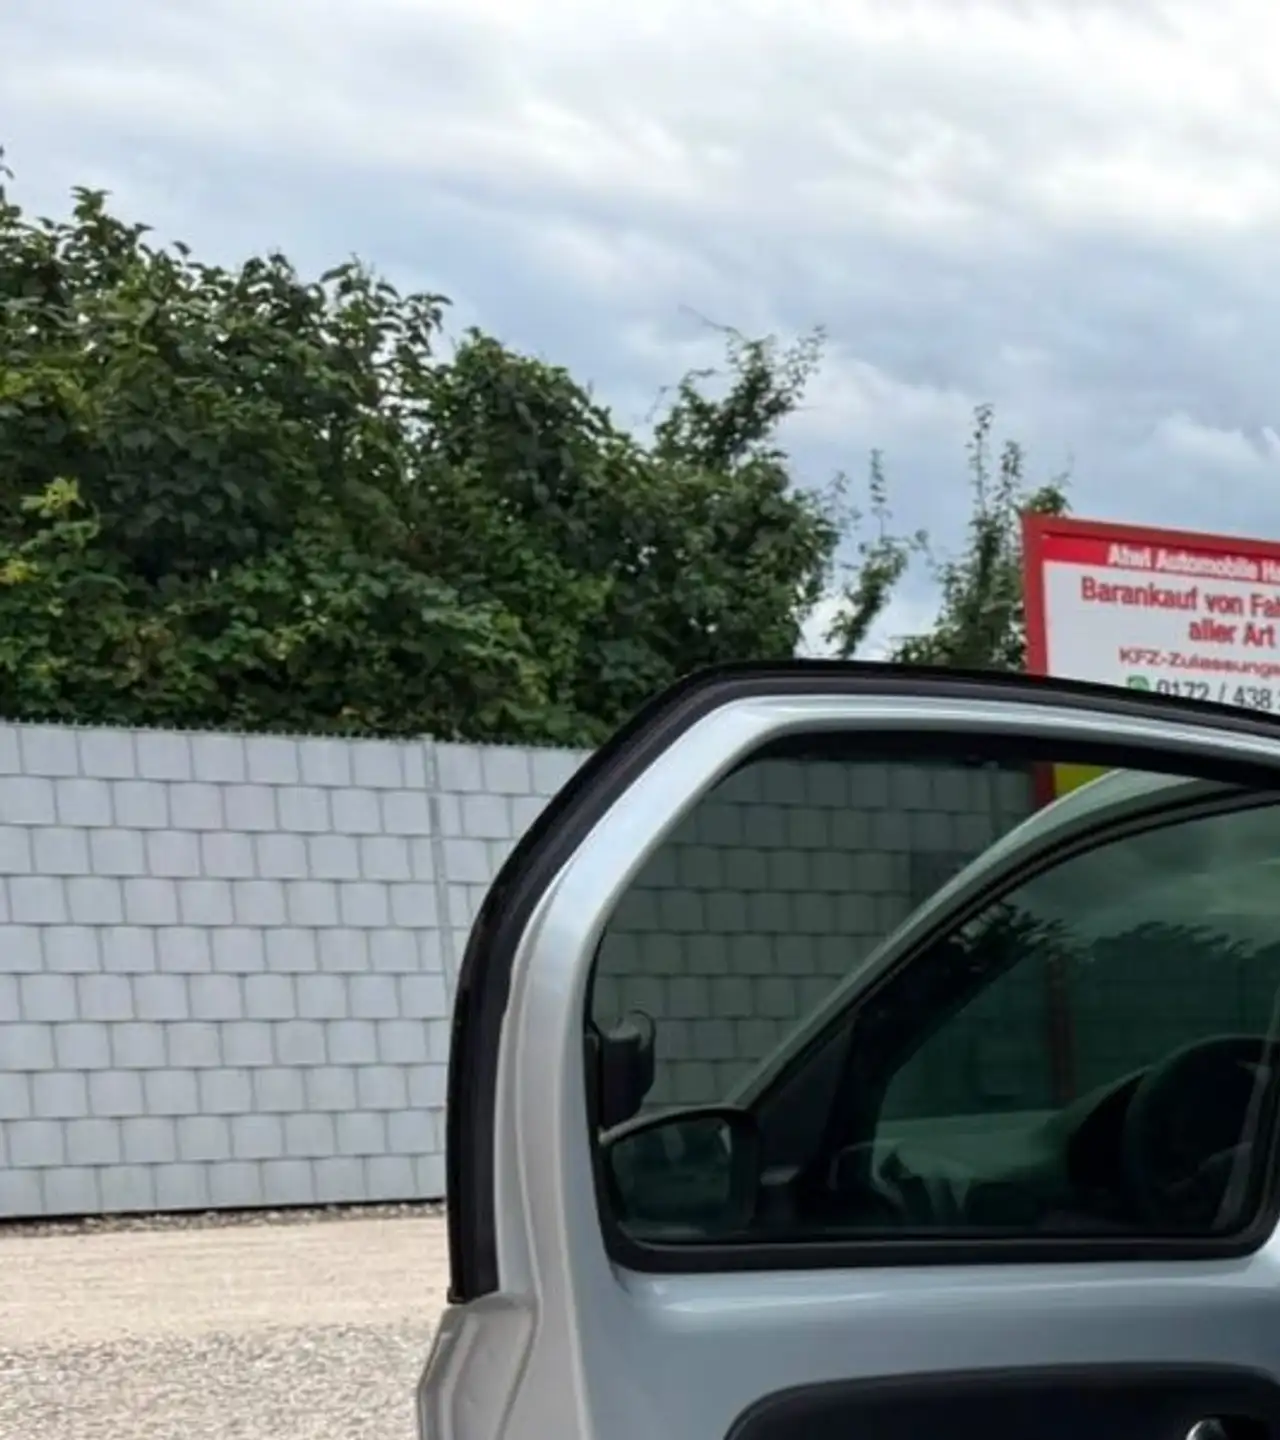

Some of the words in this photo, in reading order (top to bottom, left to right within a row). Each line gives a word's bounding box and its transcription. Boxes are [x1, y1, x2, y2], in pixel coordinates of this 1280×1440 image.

[1155, 549, 1259, 580] Automobile
[1082, 575, 1198, 611] Barankauf
[1204, 593, 1244, 616] von
[1188, 618, 1237, 645] aller
[1243, 622, 1276, 648] Art
[1156, 678, 1210, 700] 0172
[1233, 686, 1273, 710] 438
